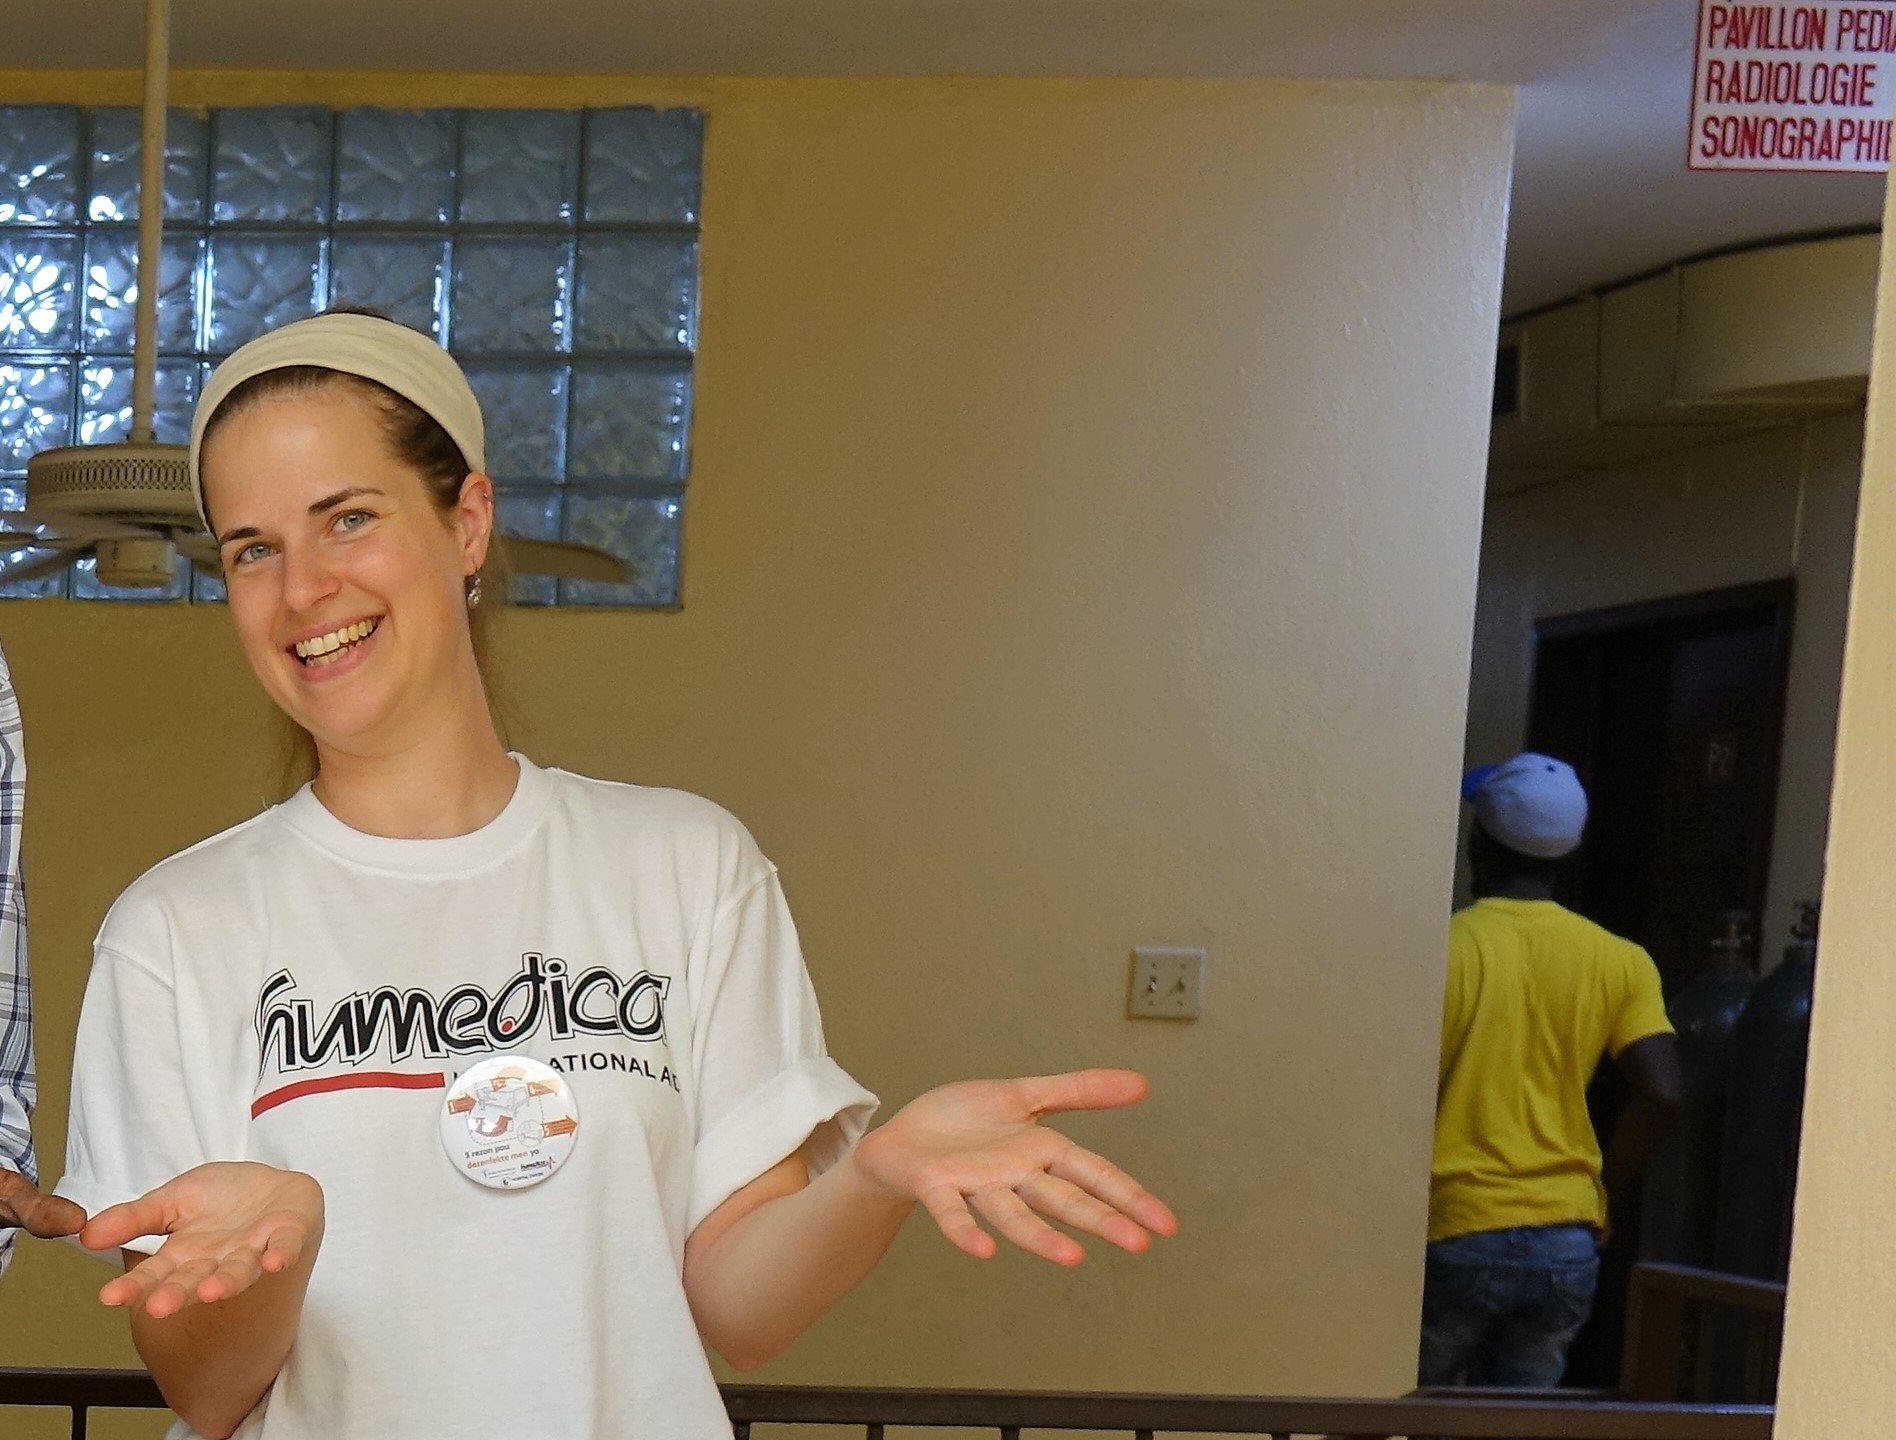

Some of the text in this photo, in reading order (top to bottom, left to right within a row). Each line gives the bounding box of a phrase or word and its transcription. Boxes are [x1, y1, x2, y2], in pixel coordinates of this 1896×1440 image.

[1708, 6, 1827, 50] PAVILLON
[1706, 60, 1876, 107] RADIOLOGIE
[254, 952, 671, 1085] humedica
